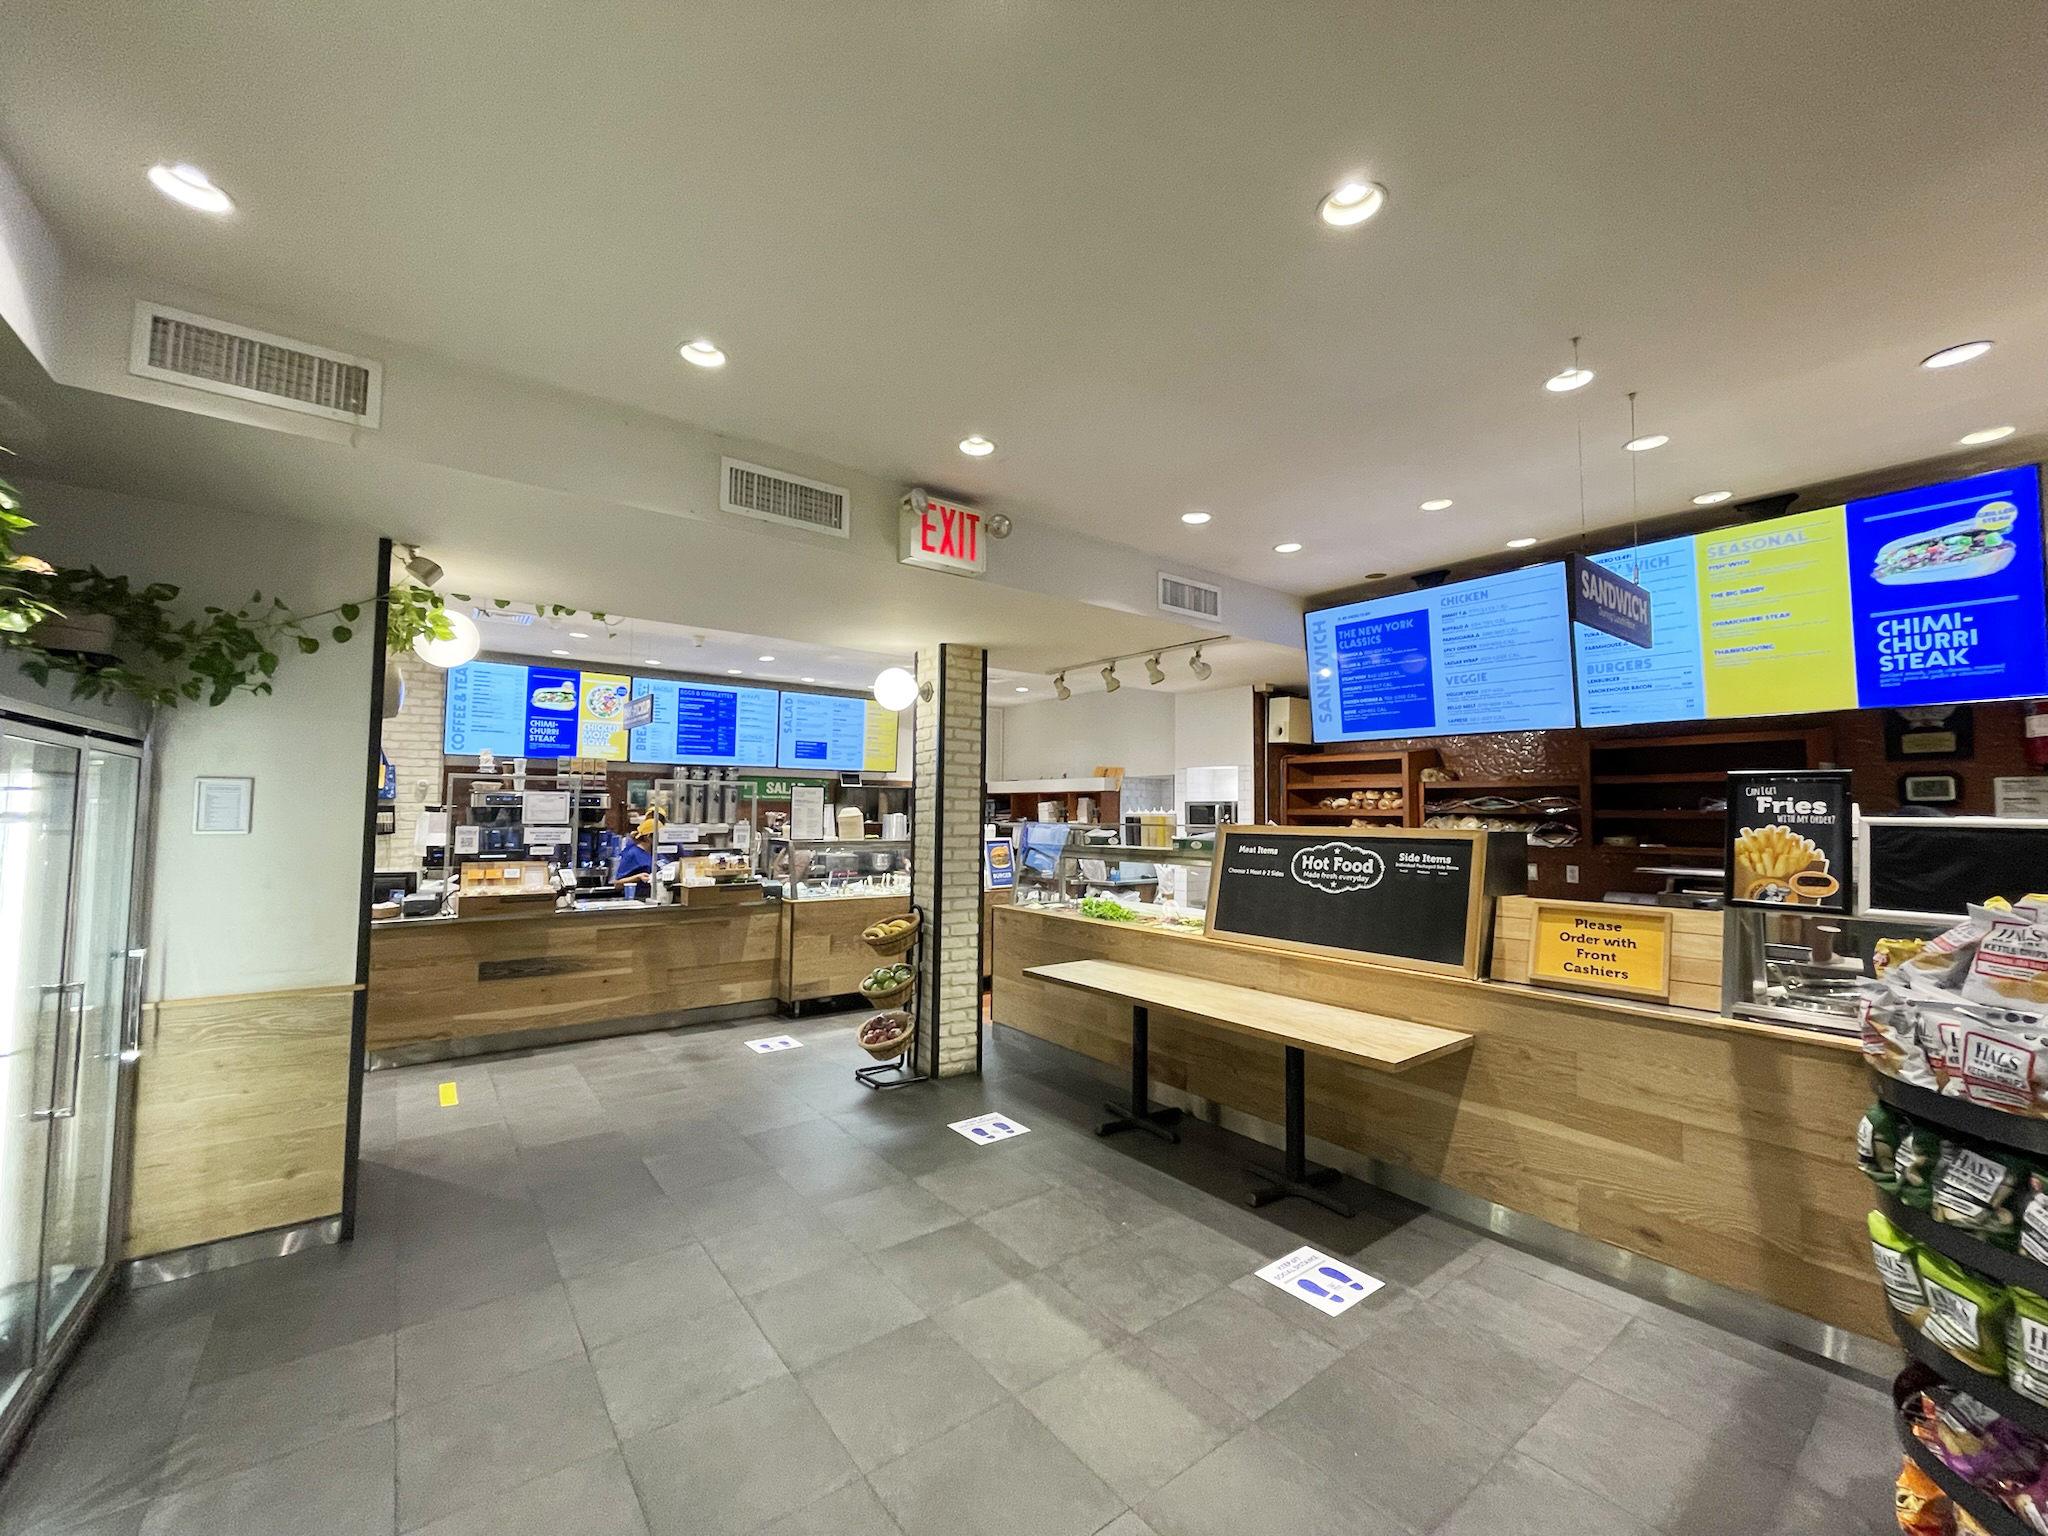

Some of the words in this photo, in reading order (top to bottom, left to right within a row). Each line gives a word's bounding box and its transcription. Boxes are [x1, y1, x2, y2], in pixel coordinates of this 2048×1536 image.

[921, 503, 980, 562] EXIT
[1707, 529, 1809, 559] SEASONAL
[1740, 586, 1766, 594] DADDY
[1440, 589, 1489, 607] CHICKEN
[1581, 570, 1649, 625] SANDWICH
[1765, 612, 1792, 620] STEAK
[1338, 628, 1356, 640] THE
[1358, 624, 1383, 636] NEW
[1385, 618, 1414, 631] YORK
[1876, 612, 1974, 637] CHIMI-
[1338, 635, 1382, 649] CLASSICS
[1584, 641, 1622, 651] FARMHOUSE
[1877, 628, 1979, 654] CHURRI
[1586, 658, 1653, 675] BURGERS
[1878, 647, 1970, 672] STEAK
[1312, 619, 1334, 724] SANWICH
[1445, 672, 1488, 685] VEGGIE
[454, 667, 468, 691] TEA
[701, 691, 734, 699] OMELETTES
[1587, 685, 1631, 694] SMOKEHOUSE
[453, 693, 467, 702] &
[783, 697, 794, 734] SALAD
[451, 704, 466, 751] COFFEE
[529, 720, 559, 728] CHIMI-
[529, 727, 560, 735] CHURRI
[582, 723, 620, 733] CHICKEN
[528, 734, 556, 743] STEAK
[582, 731, 611, 739] MOJO
[765, 781, 806, 795] SAL
[1745, 786, 1760, 797] CAN
[1765, 786, 1777, 796] GET
[1756, 796, 1828, 815] Fries
[1777, 814, 1795, 824] WITH
[1796, 815, 1809, 824] MY
[1810, 814, 1836, 825] ORDER?
[1238, 845, 1257, 854] Meat
[1257, 845, 1279, 855] Items
[1302, 854, 1330, 871] Hot
[1333, 856, 1374, 874] Food
[1399, 852, 1421, 863] Side
[1421, 853, 1452, 865] Items
[992, 872, 1012, 880] BURGER
[1303, 871, 1320, 879] Made
[1321, 872, 1338, 880] fresh
[1338, 874, 1370, 884] everyday
[1575, 918, 1623, 932] Please
[1559, 932, 1601, 945] Order
[1603, 937, 1637, 949] with
[1576, 948, 1617, 962] Front
[1983, 943, 2018, 955] KETTLE
[1563, 961, 1629, 980] Cashiers
[1975, 1042, 2021, 1071] HAL'S
